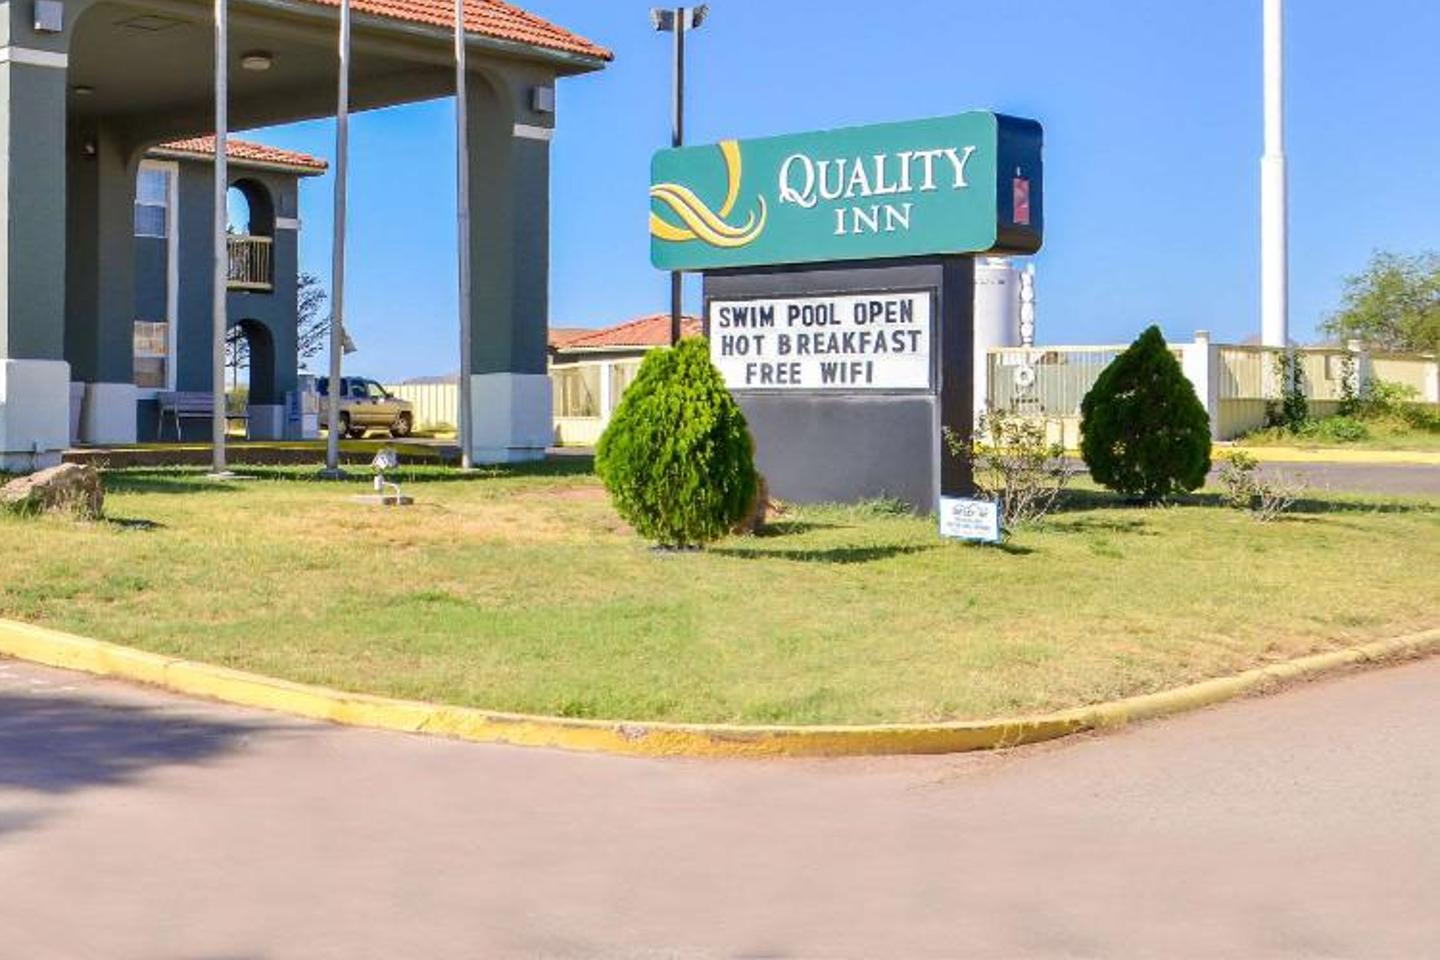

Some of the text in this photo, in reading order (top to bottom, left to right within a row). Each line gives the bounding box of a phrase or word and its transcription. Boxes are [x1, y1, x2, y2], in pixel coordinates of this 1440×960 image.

[777, 145, 976, 209] QUALITY
[833, 204, 914, 236] INN
[719, 300, 913, 328] SWIM POOL OPEN
[721, 330, 922, 356] HOT BREAKFAST
[745, 360, 874, 385] FREE WIFI
